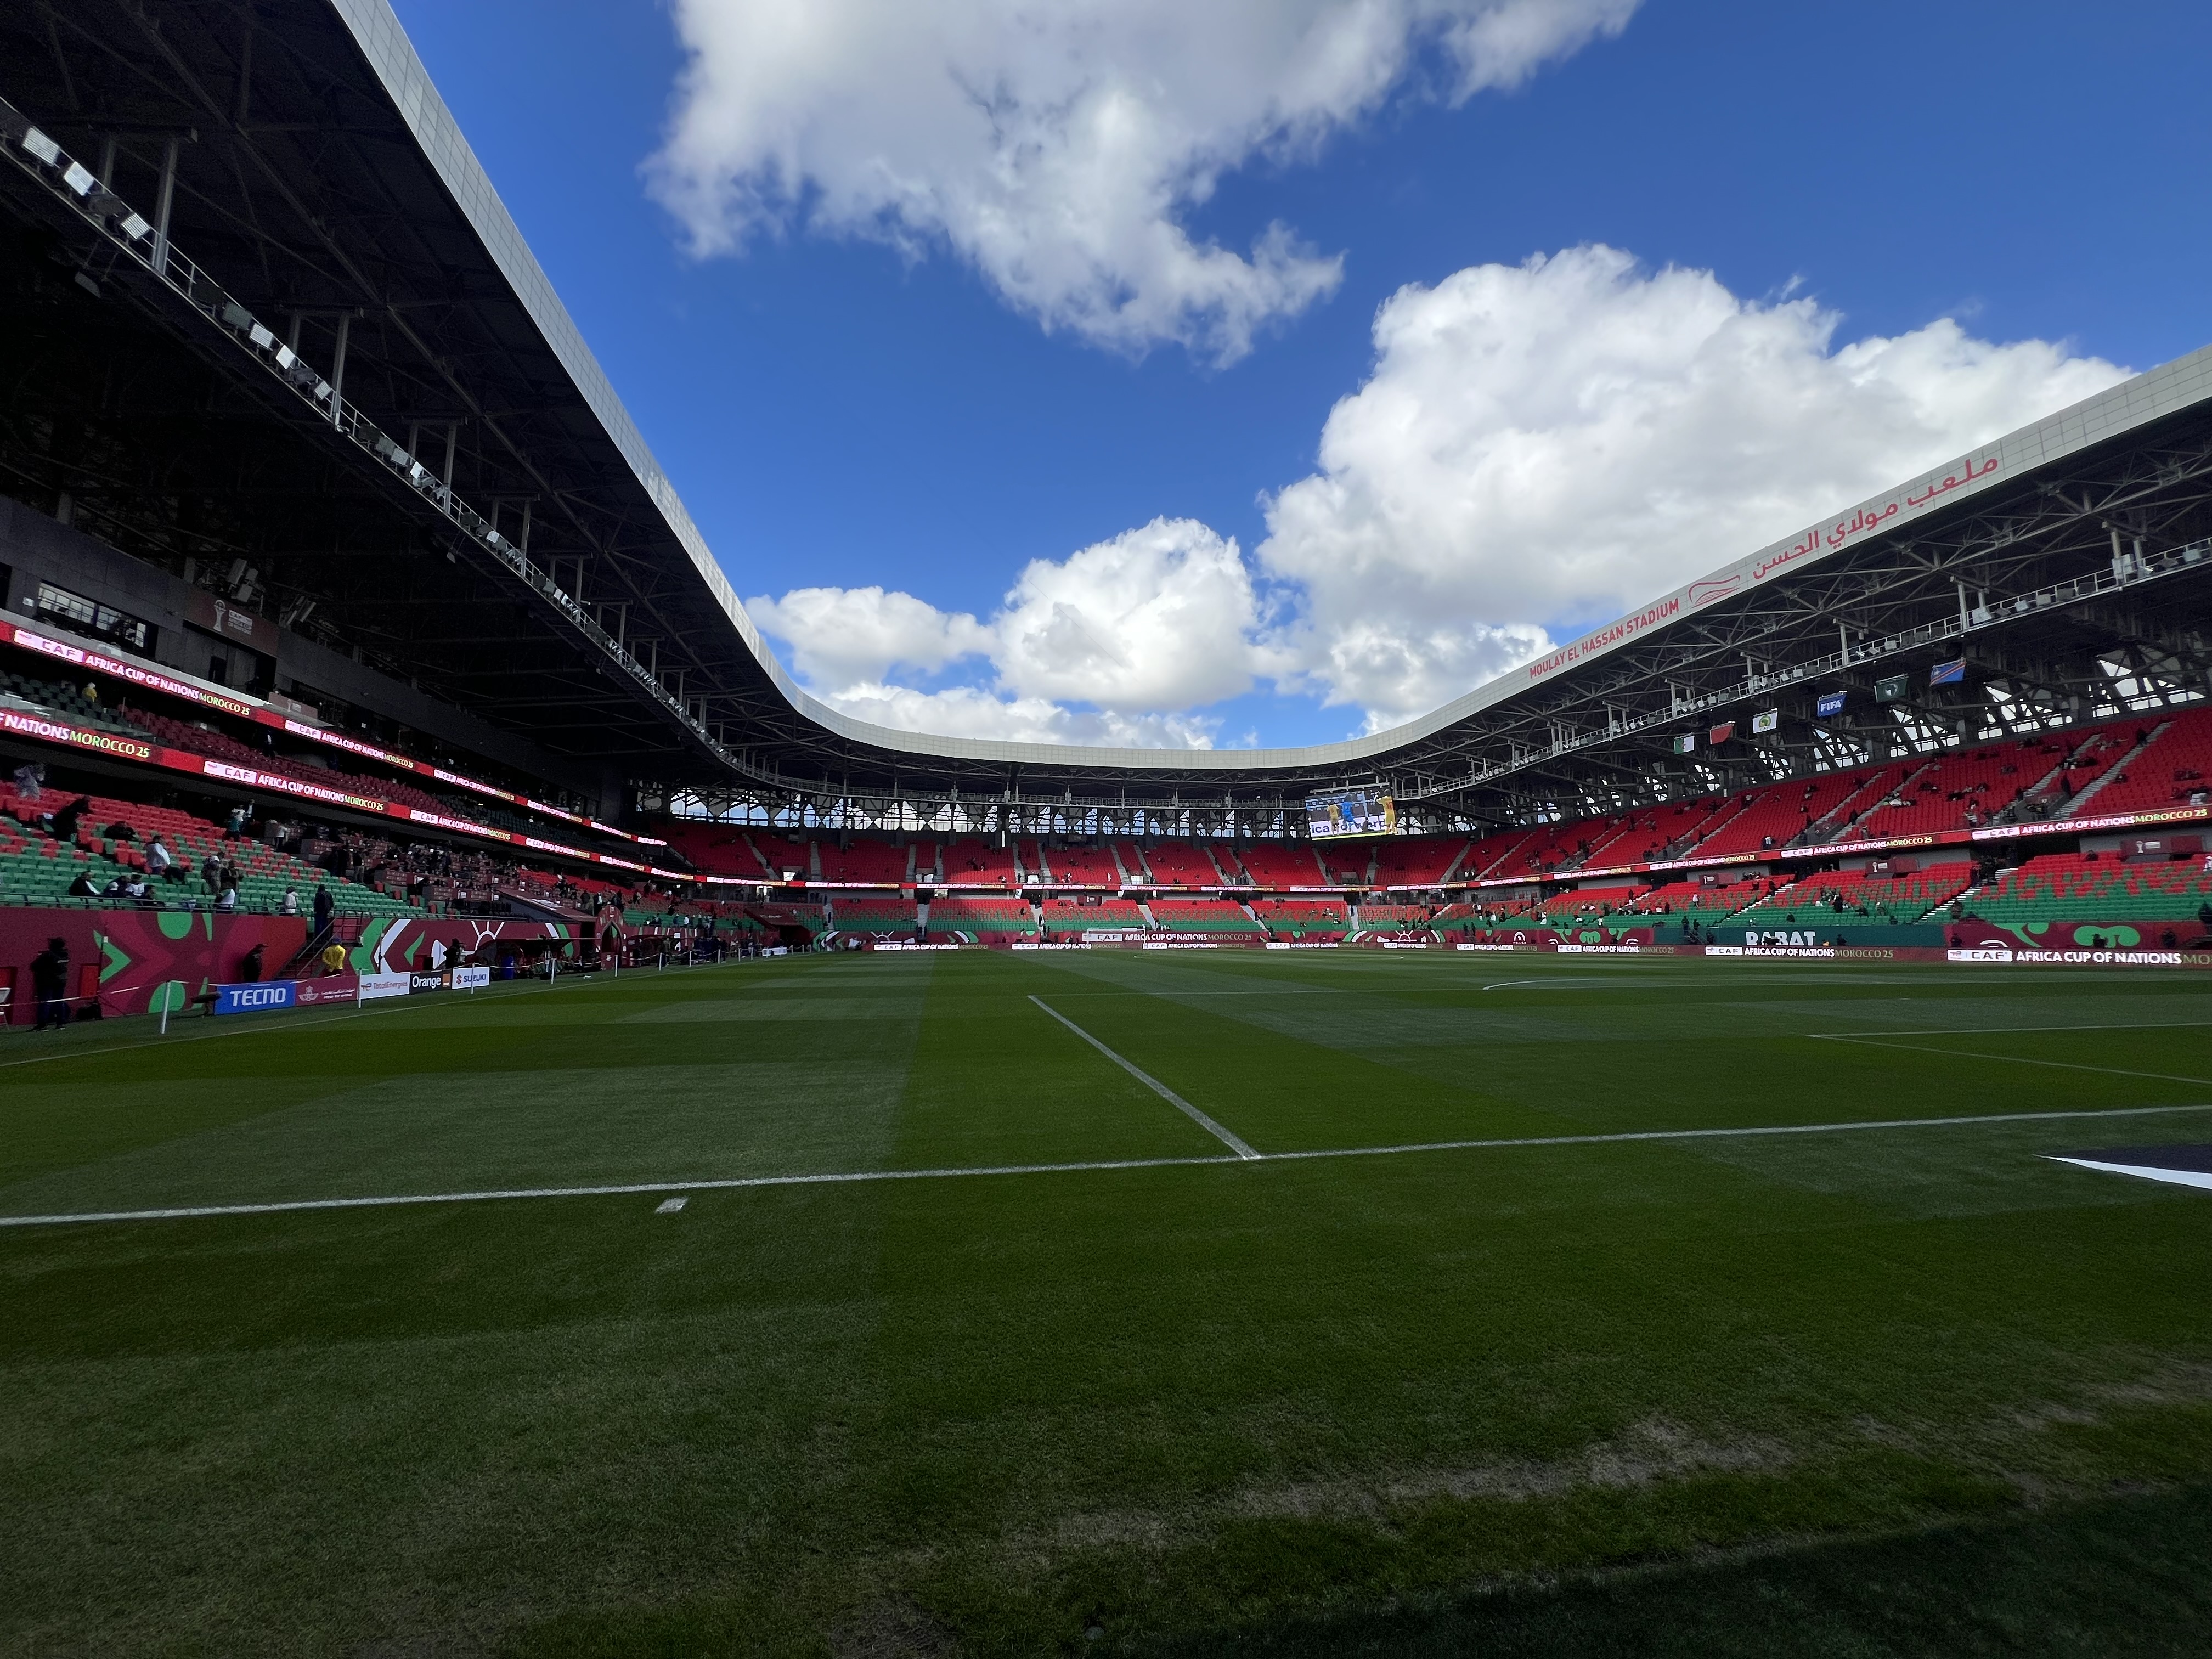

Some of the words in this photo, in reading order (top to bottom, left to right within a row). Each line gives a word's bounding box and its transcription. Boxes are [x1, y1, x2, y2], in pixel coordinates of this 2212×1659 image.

[1906, 458, 1999, 508] ملعب
[1826, 503, 1898, 549] مولاي
[1752, 529, 1819, 580] الحسن
[1530, 651, 1565, 679] MOULAY
[1567, 646, 1580, 662] EL
[1582, 624, 1623, 655] HASSAN
[1626, 597, 1679, 634] STADIUM
[42, 641, 76, 657] CAF
[86, 654, 125, 675] AFRICA
[126, 668, 146, 681] CUP
[146, 675, 161, 686] OF
[160, 679, 199, 699] NATIONS
[199, 692, 240, 713] MOROCCO
[241, 706, 250, 716] 25
[1820, 699, 1842, 713] FIFA
[4, 714, 70, 740] NATIONS
[70, 731, 135, 754] MOROCCO
[136, 746, 150, 758] 25
[299, 726, 317, 737] CAF
[225, 768, 251, 779] CAF
[257, 774, 287, 789] AFRICA
[288, 781, 303, 792] CUP
[304, 785, 314, 795] OF
[315, 787, 344, 802] NATIONS
[345, 795, 375, 809] MOROCCO
[376, 802, 383, 811] 25
[1311, 825, 1329, 833] ica
[2022, 824, 2055, 833] AFRICA
[2090, 816, 2135, 827] NATIONS
[2135, 810, 2192, 822] MOROCCO
[2194, 809, 2208, 817] 25
[1858, 841, 1887, 849] NATIONS
[1887, 837, 1923, 847] MOROCCO
[1798, 949, 1835, 957] NATIONS
[1835, 949, 1881, 957] MOROCCO
[2016, 951, 2062, 961] AFRICA
[2063, 951, 2091, 962] CUP
[2092, 952, 2112, 962] OF
[2114, 952, 2182, 964] NATIONS
[412, 975, 441, 989] Orange
[230, 988, 286, 1007] TECNO
